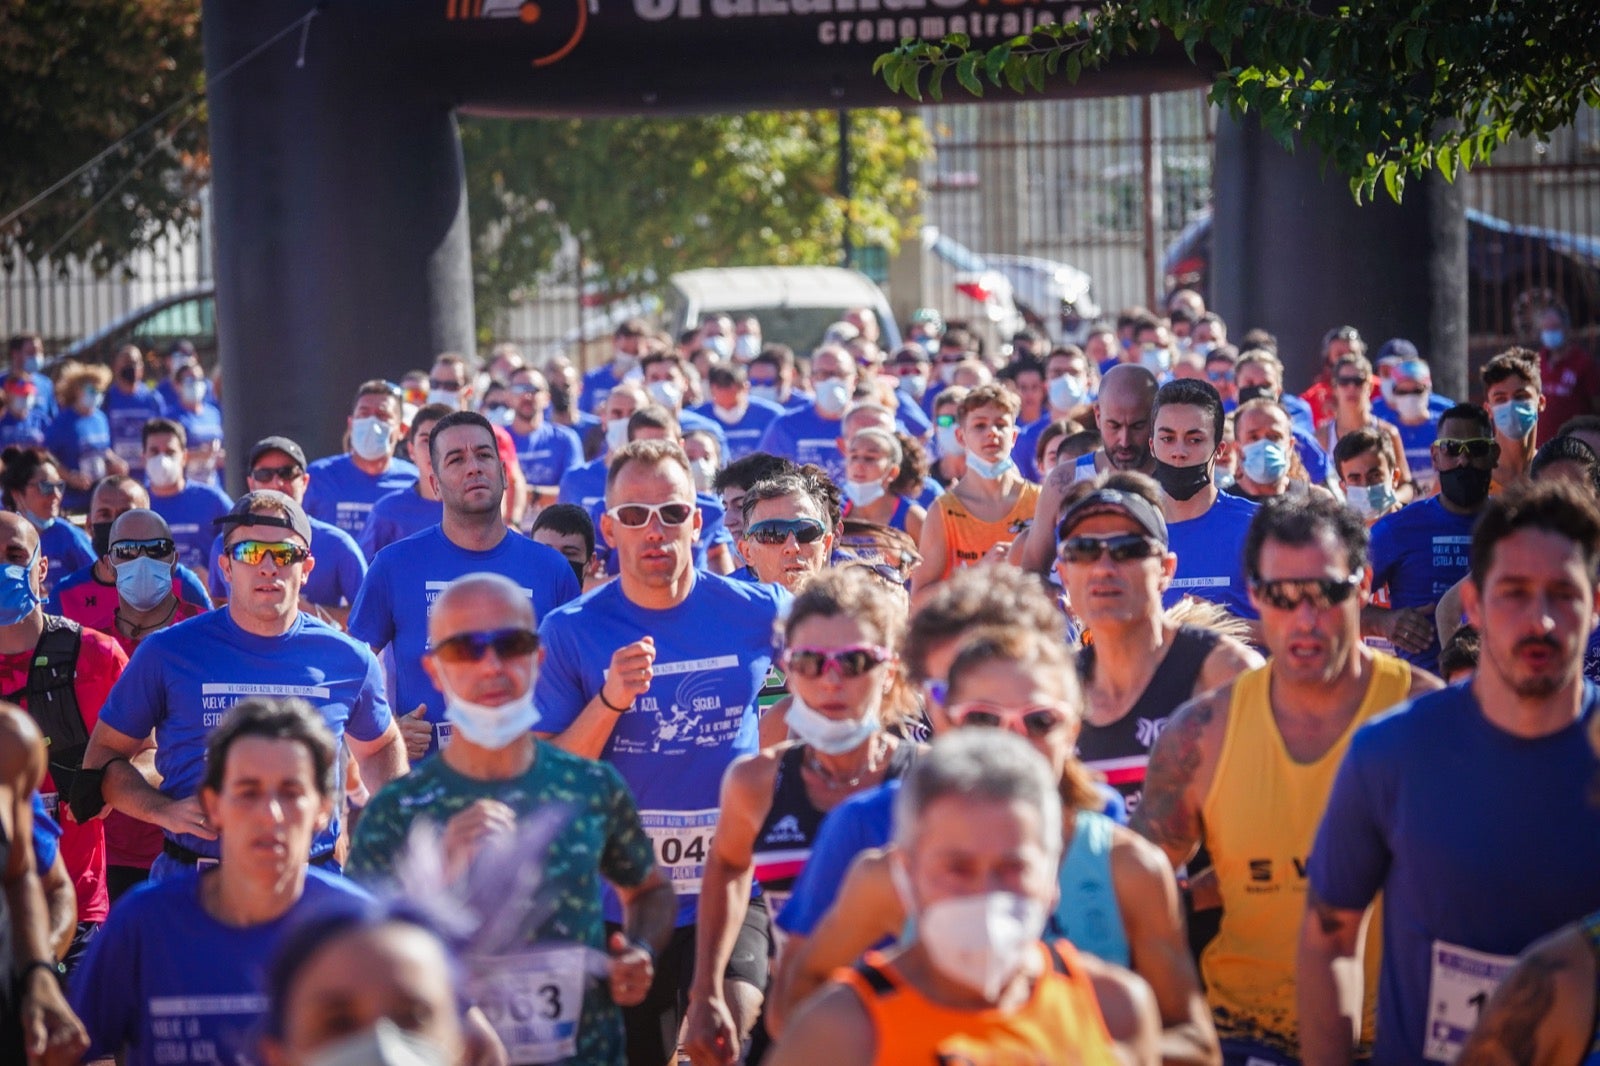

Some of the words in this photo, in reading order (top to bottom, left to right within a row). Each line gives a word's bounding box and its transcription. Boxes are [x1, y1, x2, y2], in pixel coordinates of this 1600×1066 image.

[202, 696, 226, 709] VUELVE
[641, 697, 659, 712] AZUL
[650, 835, 713, 865] 04
